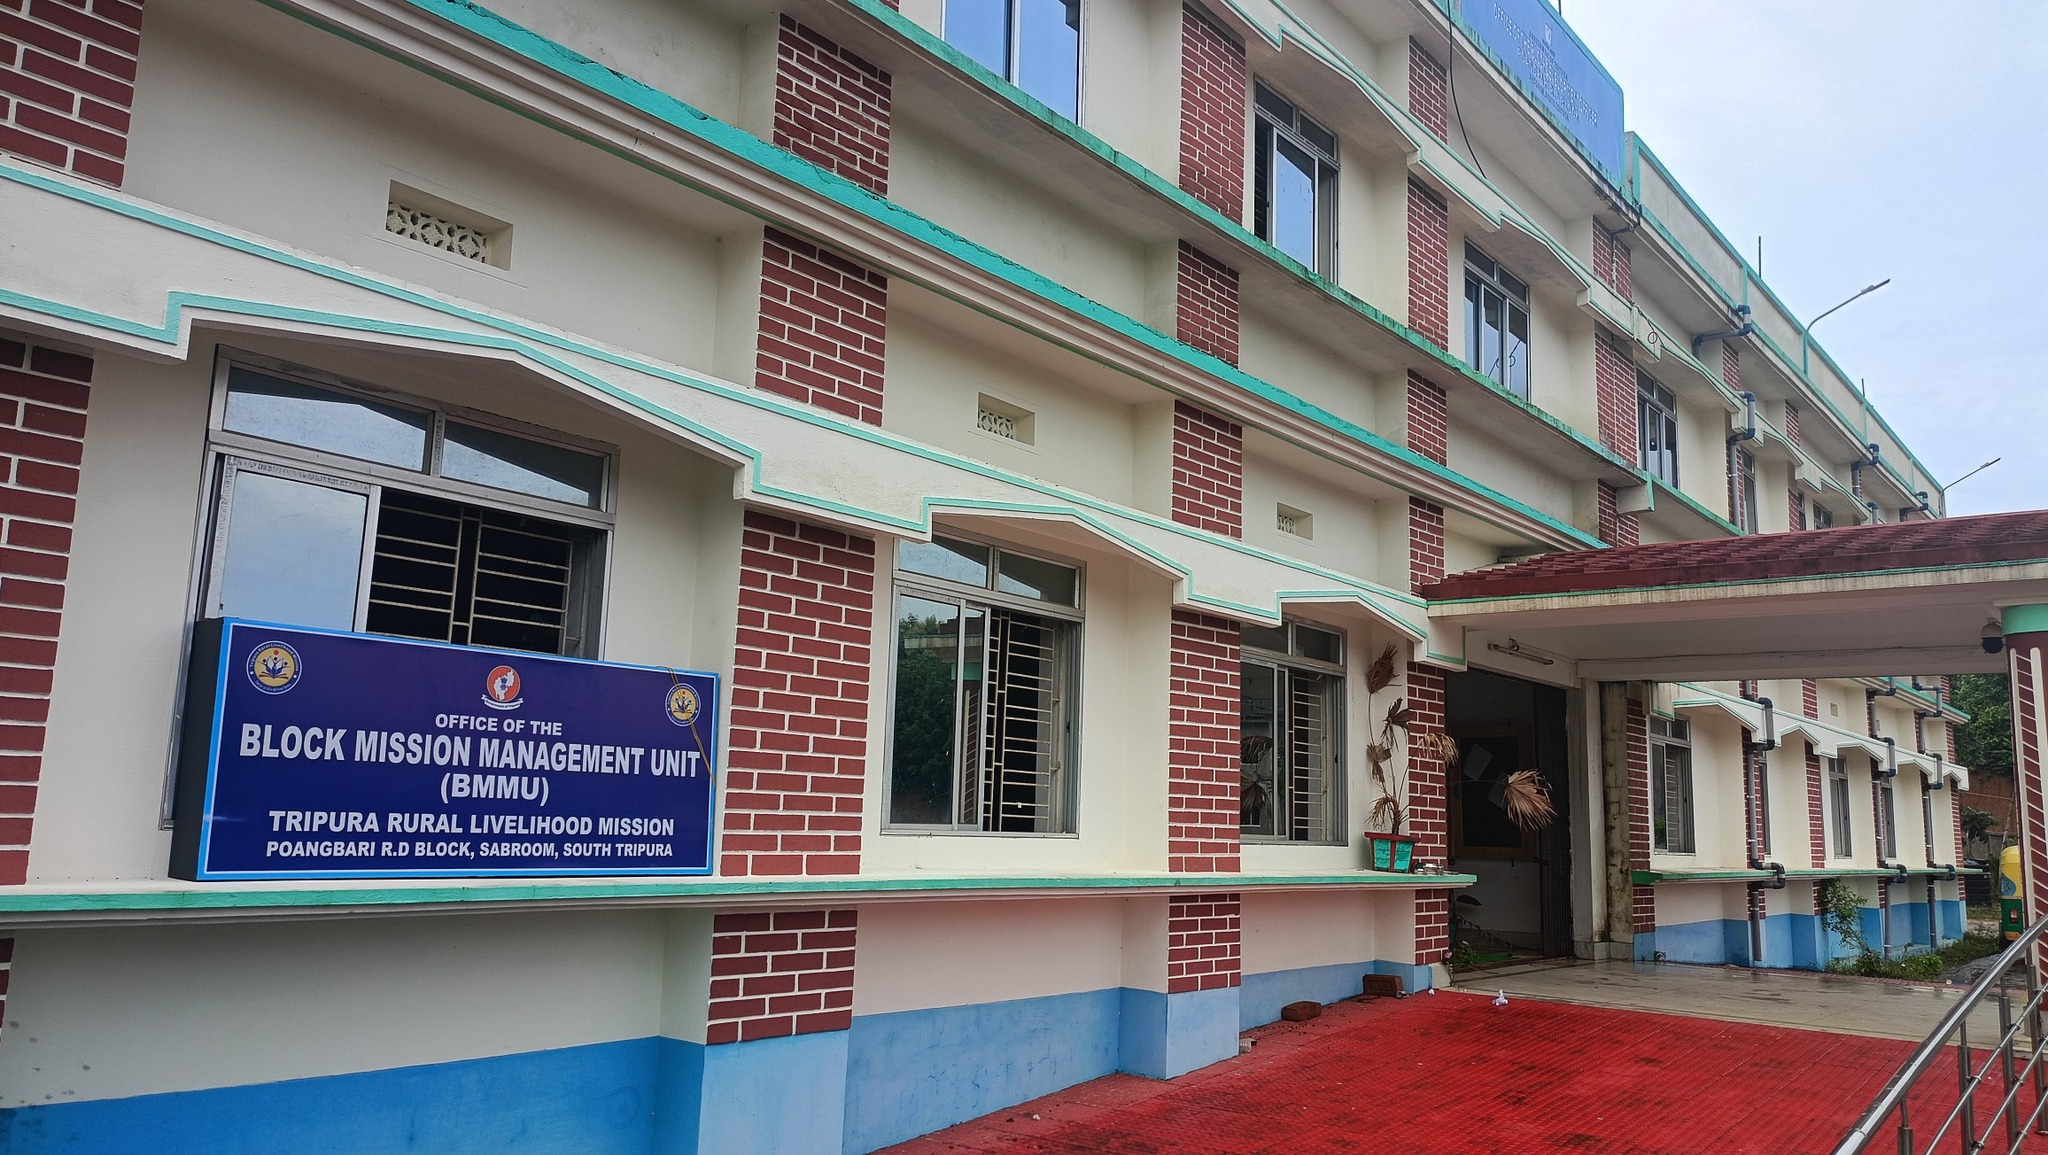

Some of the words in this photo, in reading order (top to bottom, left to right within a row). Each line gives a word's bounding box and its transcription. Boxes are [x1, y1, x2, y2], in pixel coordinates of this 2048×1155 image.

[436, 714, 498, 731] OFFICE
[503, 719, 526, 733] OF
[530, 721, 563, 736] THE
[240, 724, 346, 760] BLOCK
[354, 731, 471, 766] MISSION
[478, 738, 645, 775] MANAGEMENT
[650, 749, 701, 777] UNIT
[440, 773, 549, 806] (BMMU)
[269, 811, 379, 832] TRIPURA
[387, 813, 463, 833] RURAL
[470, 815, 593, 835] LIVELIHOOD
[599, 818, 675, 836] MISSION
[266, 842, 376, 857] POANGBARI
[381, 842, 409, 857] R.D
[415, 842, 475, 860] BLOCK,
[480, 842, 559, 860] SABROOM,
[563, 843, 612, 857] SOUTH
[615, 844, 673, 857] TRIPURA
